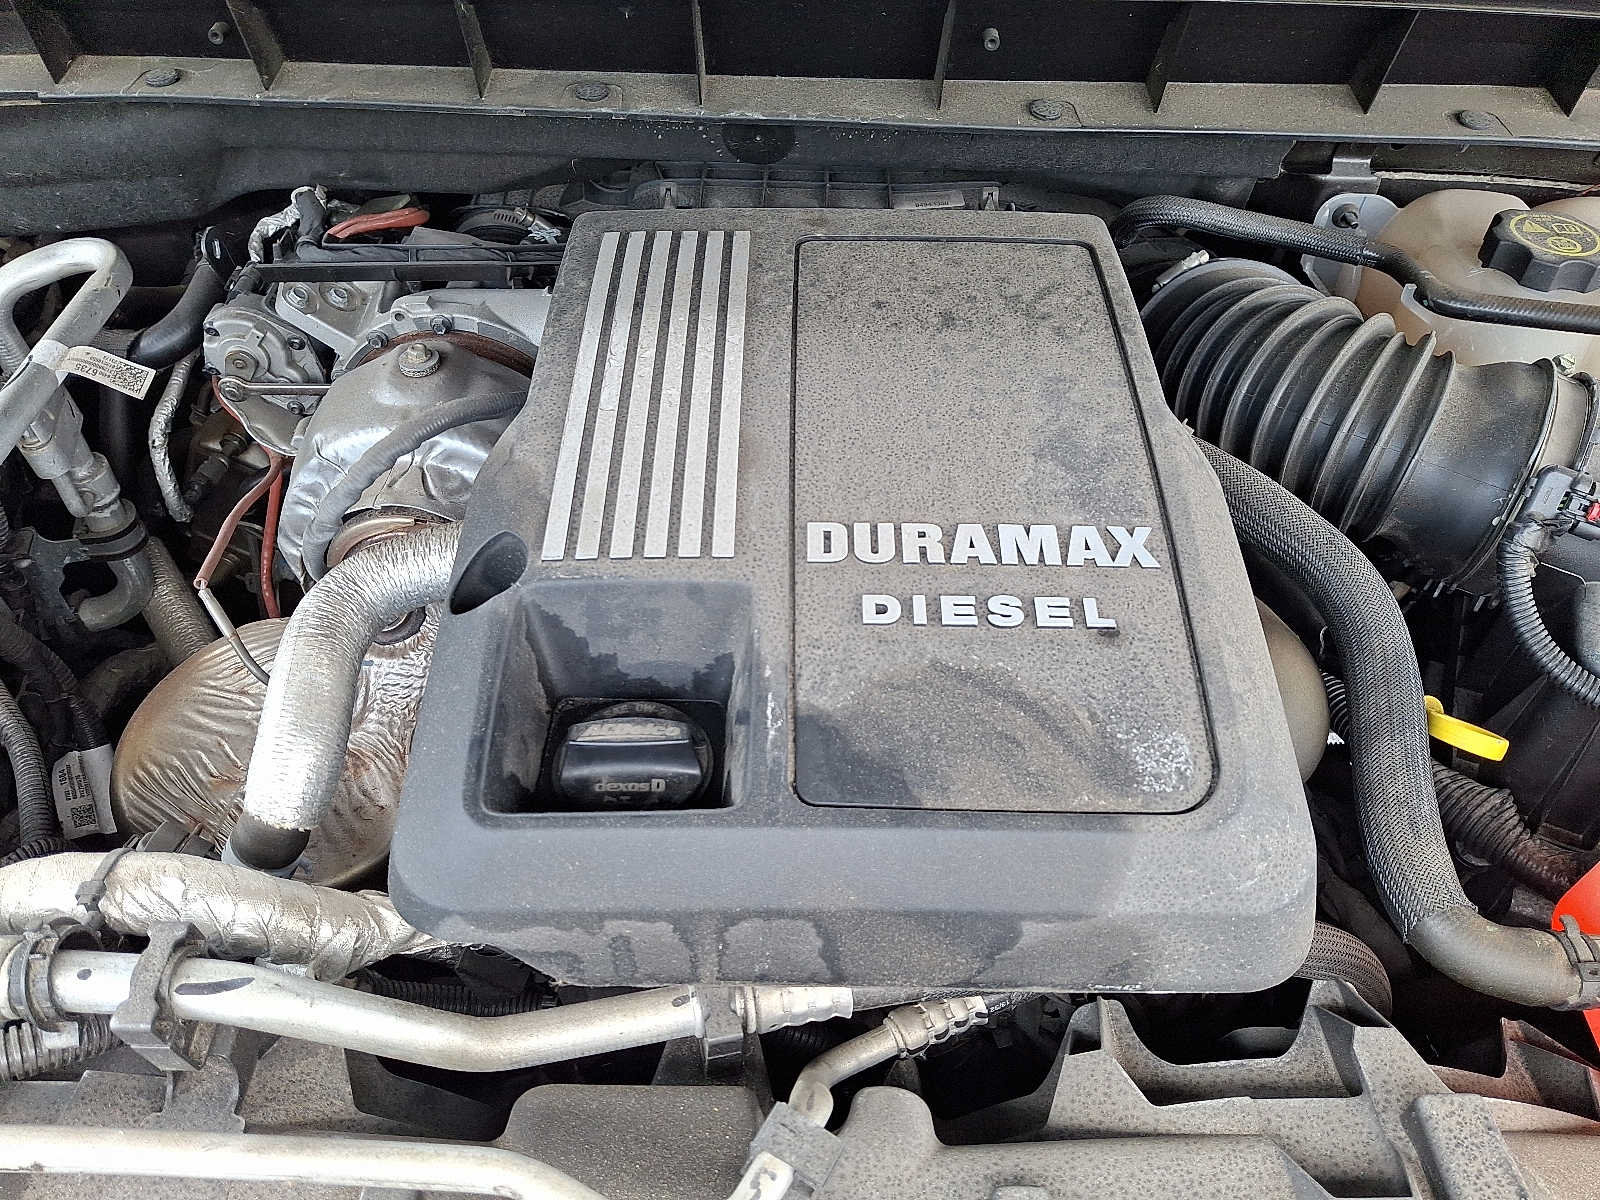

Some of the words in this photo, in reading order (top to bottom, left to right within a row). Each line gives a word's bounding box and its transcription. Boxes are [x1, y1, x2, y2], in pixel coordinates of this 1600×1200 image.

[75, 363, 97, 376] 6735
[806, 522, 1161, 568] DURAMAX
[862, 594, 1117, 629] DIESEL
